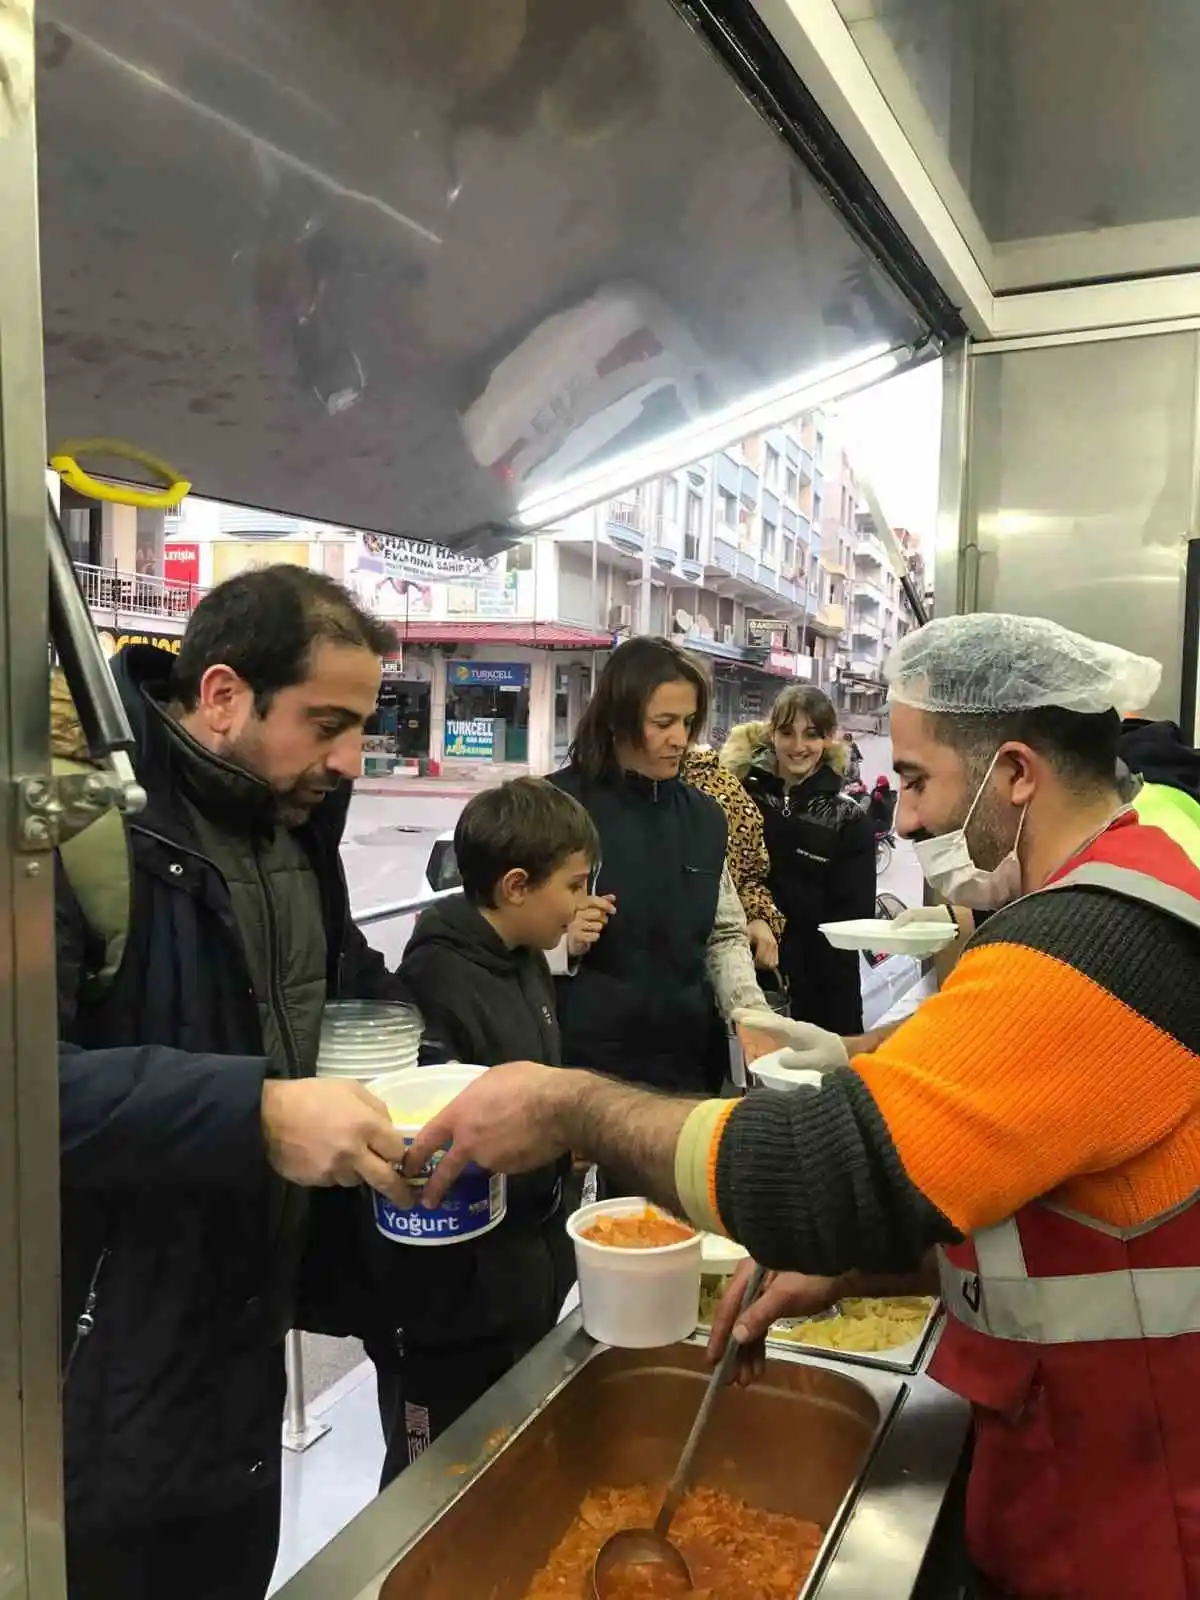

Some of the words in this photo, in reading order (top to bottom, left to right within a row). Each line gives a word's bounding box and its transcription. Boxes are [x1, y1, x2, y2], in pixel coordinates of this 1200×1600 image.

[471, 669, 513, 679] TURKCELL
[446, 719, 493, 737] TURKCELL
[383, 1209, 461, 1237] Yoğurt
